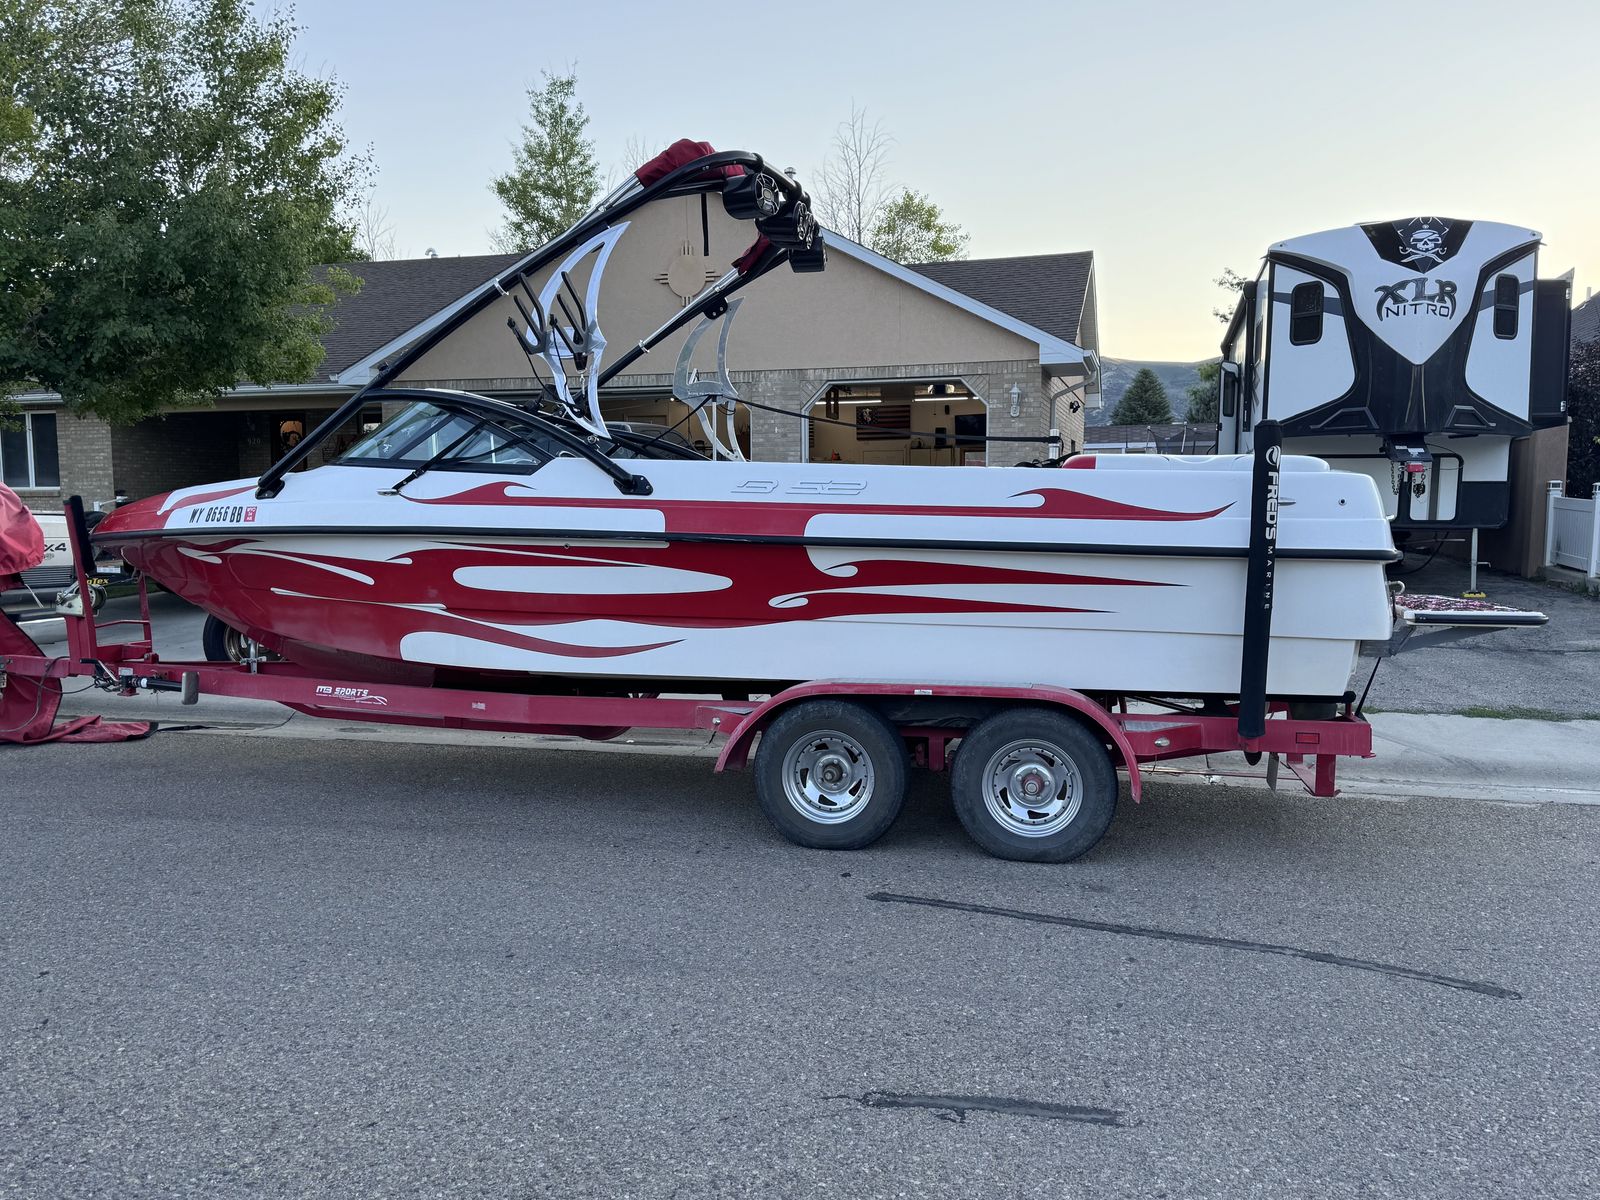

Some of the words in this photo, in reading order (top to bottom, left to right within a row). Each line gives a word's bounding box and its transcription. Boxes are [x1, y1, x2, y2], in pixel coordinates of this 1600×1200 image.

[1374, 277, 1458, 322] XLR
[1384, 303, 1450, 318] NITRO
[189, 508, 205, 523] WY
[205, 505, 230, 523] 8656
[229, 506, 243, 523] BB
[1265, 471, 1279, 540] FRED'S
[1264, 545, 1273, 609] MARINE
[315, 685, 333, 694] MB
[334, 687, 369, 697] SPORTS
